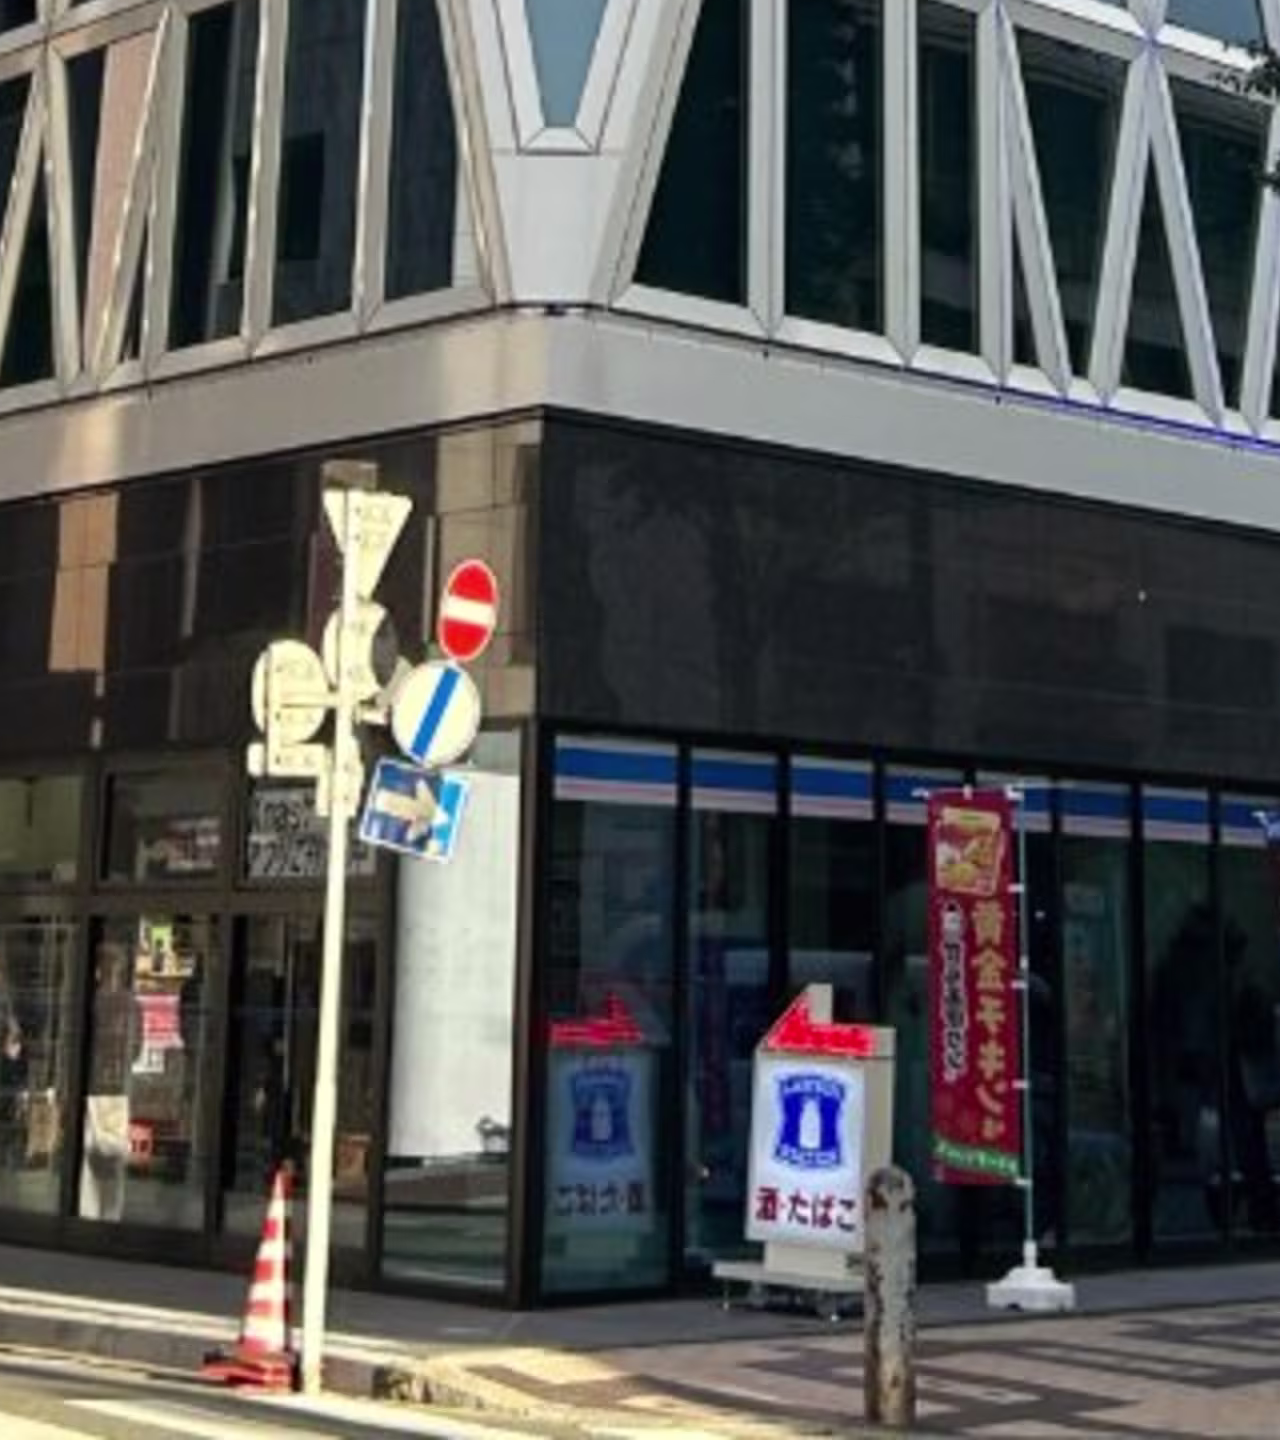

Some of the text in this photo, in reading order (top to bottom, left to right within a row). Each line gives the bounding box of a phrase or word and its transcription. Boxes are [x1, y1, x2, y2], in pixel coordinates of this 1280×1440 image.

[754, 1186, 856, 1232] 酒・たばこ
